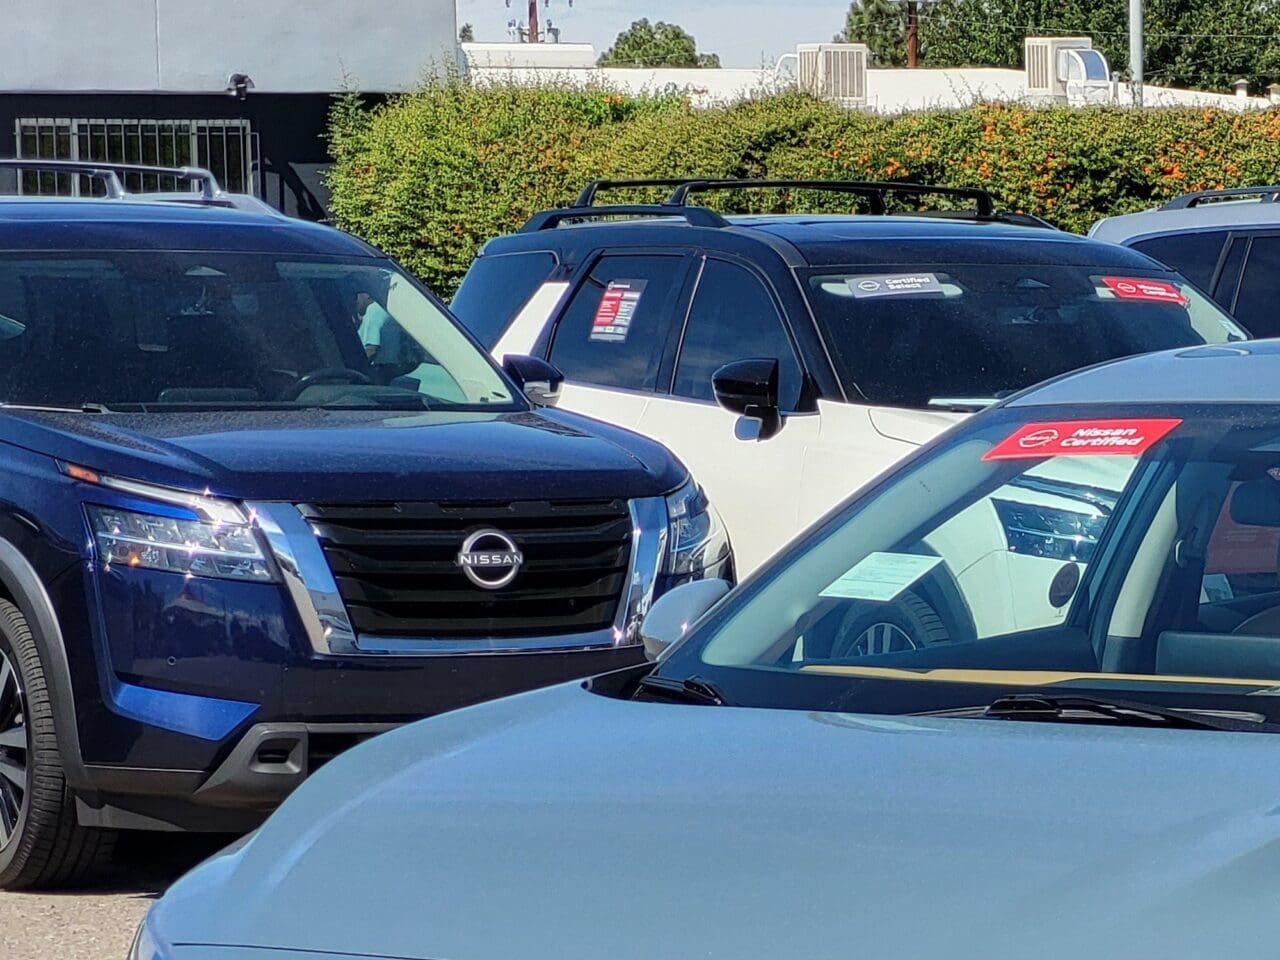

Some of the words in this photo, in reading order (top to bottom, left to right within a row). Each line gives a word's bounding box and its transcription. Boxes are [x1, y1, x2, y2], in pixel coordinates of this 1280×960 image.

[885, 277, 930, 285] Certified
[1071, 427, 1138, 437] Nissan
[1060, 436, 1144, 447] Certified
[460, 554, 523, 565] NISSAN
